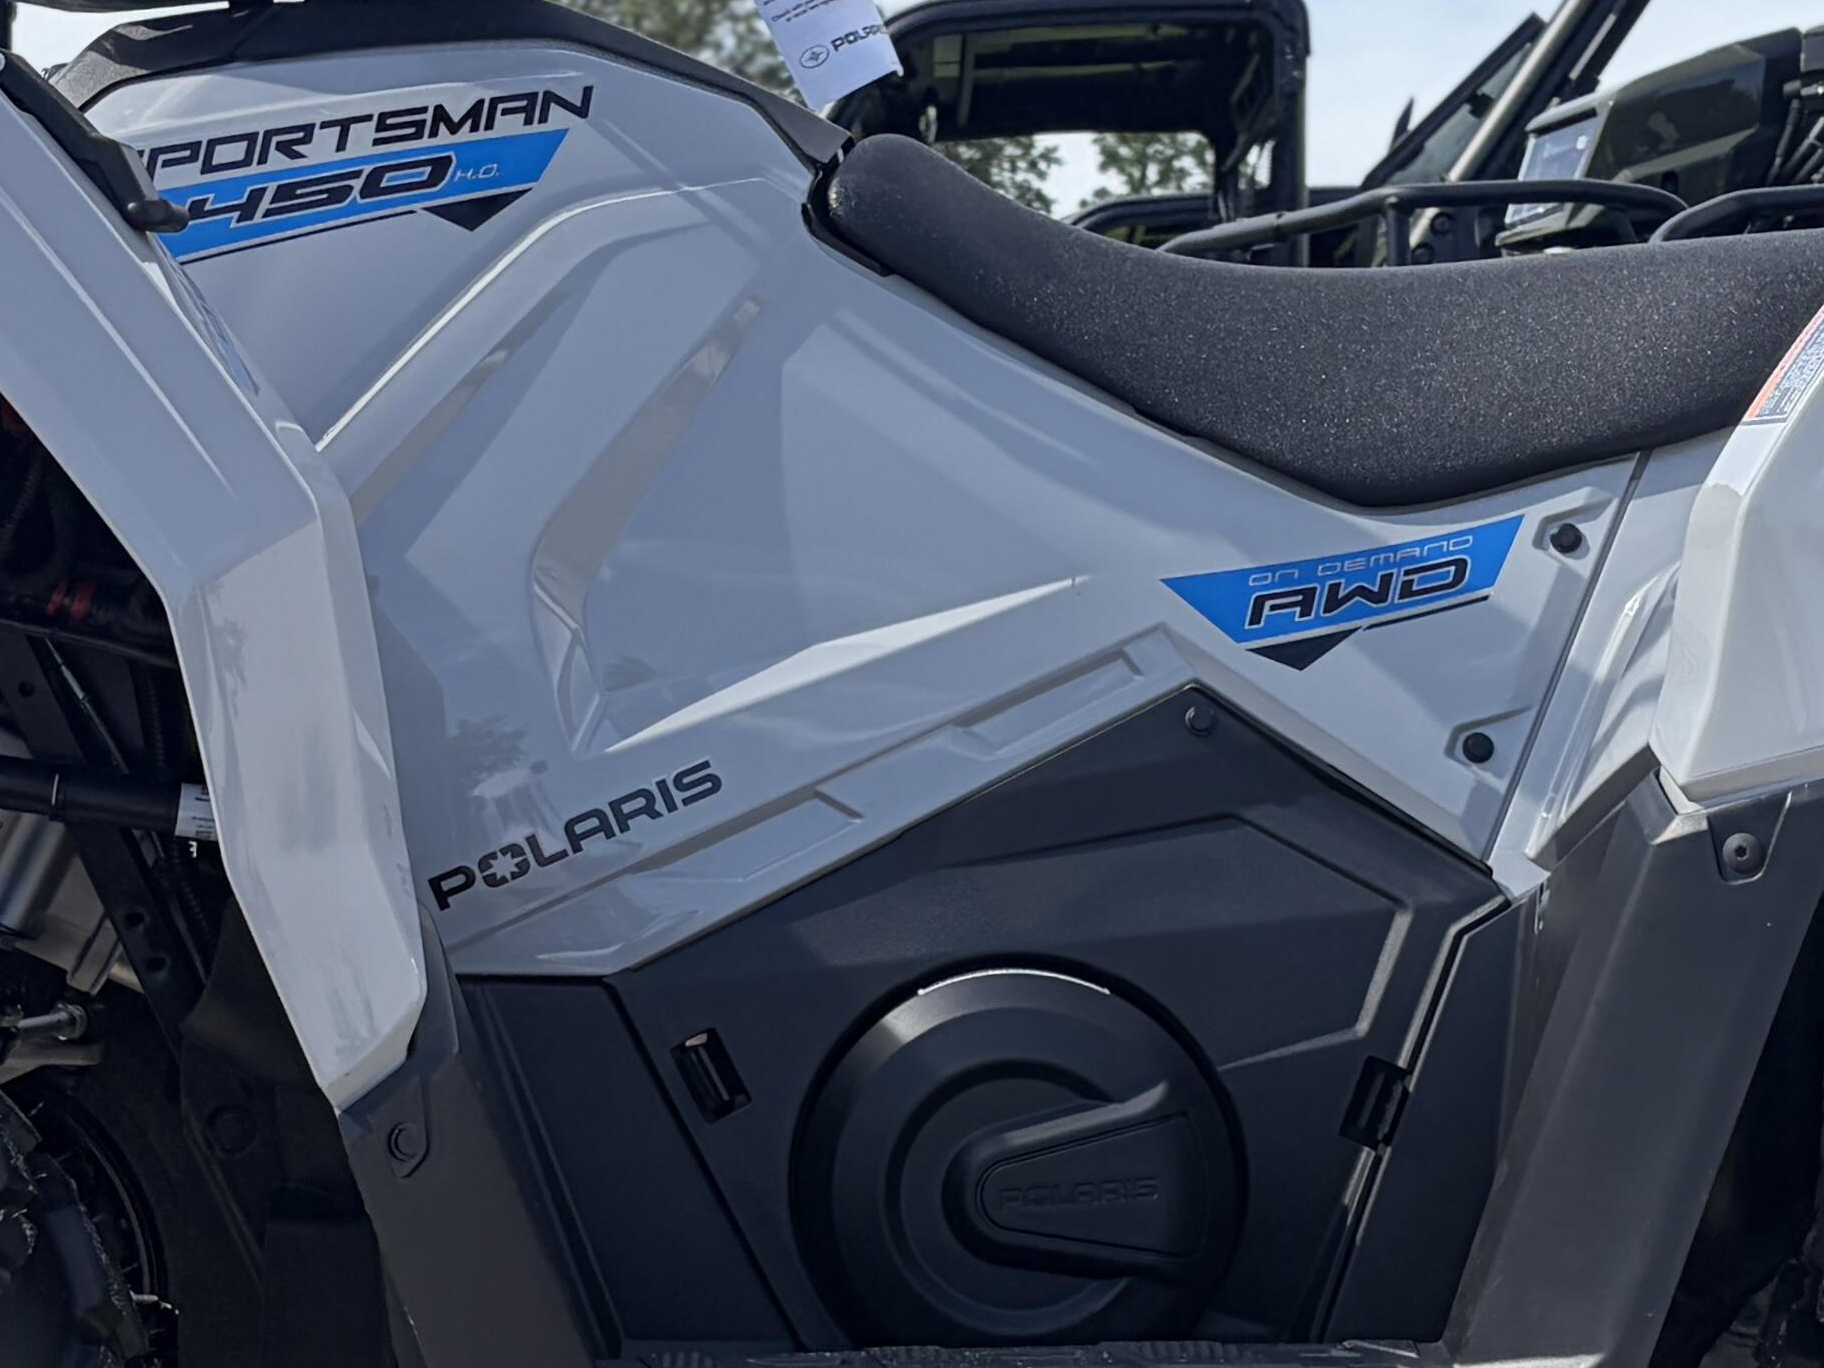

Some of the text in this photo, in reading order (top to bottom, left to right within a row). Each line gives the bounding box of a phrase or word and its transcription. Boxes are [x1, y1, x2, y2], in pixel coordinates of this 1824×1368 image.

[138, 85, 594, 181] PORTSMAN
[187, 151, 500, 229] 450 H.O.
[1244, 555, 1472, 630] AWD
[1248, 535, 1474, 587] ON DEMAND
[427, 759, 723, 911] POLARIS
[997, 1176, 1161, 1210] POLARIS
